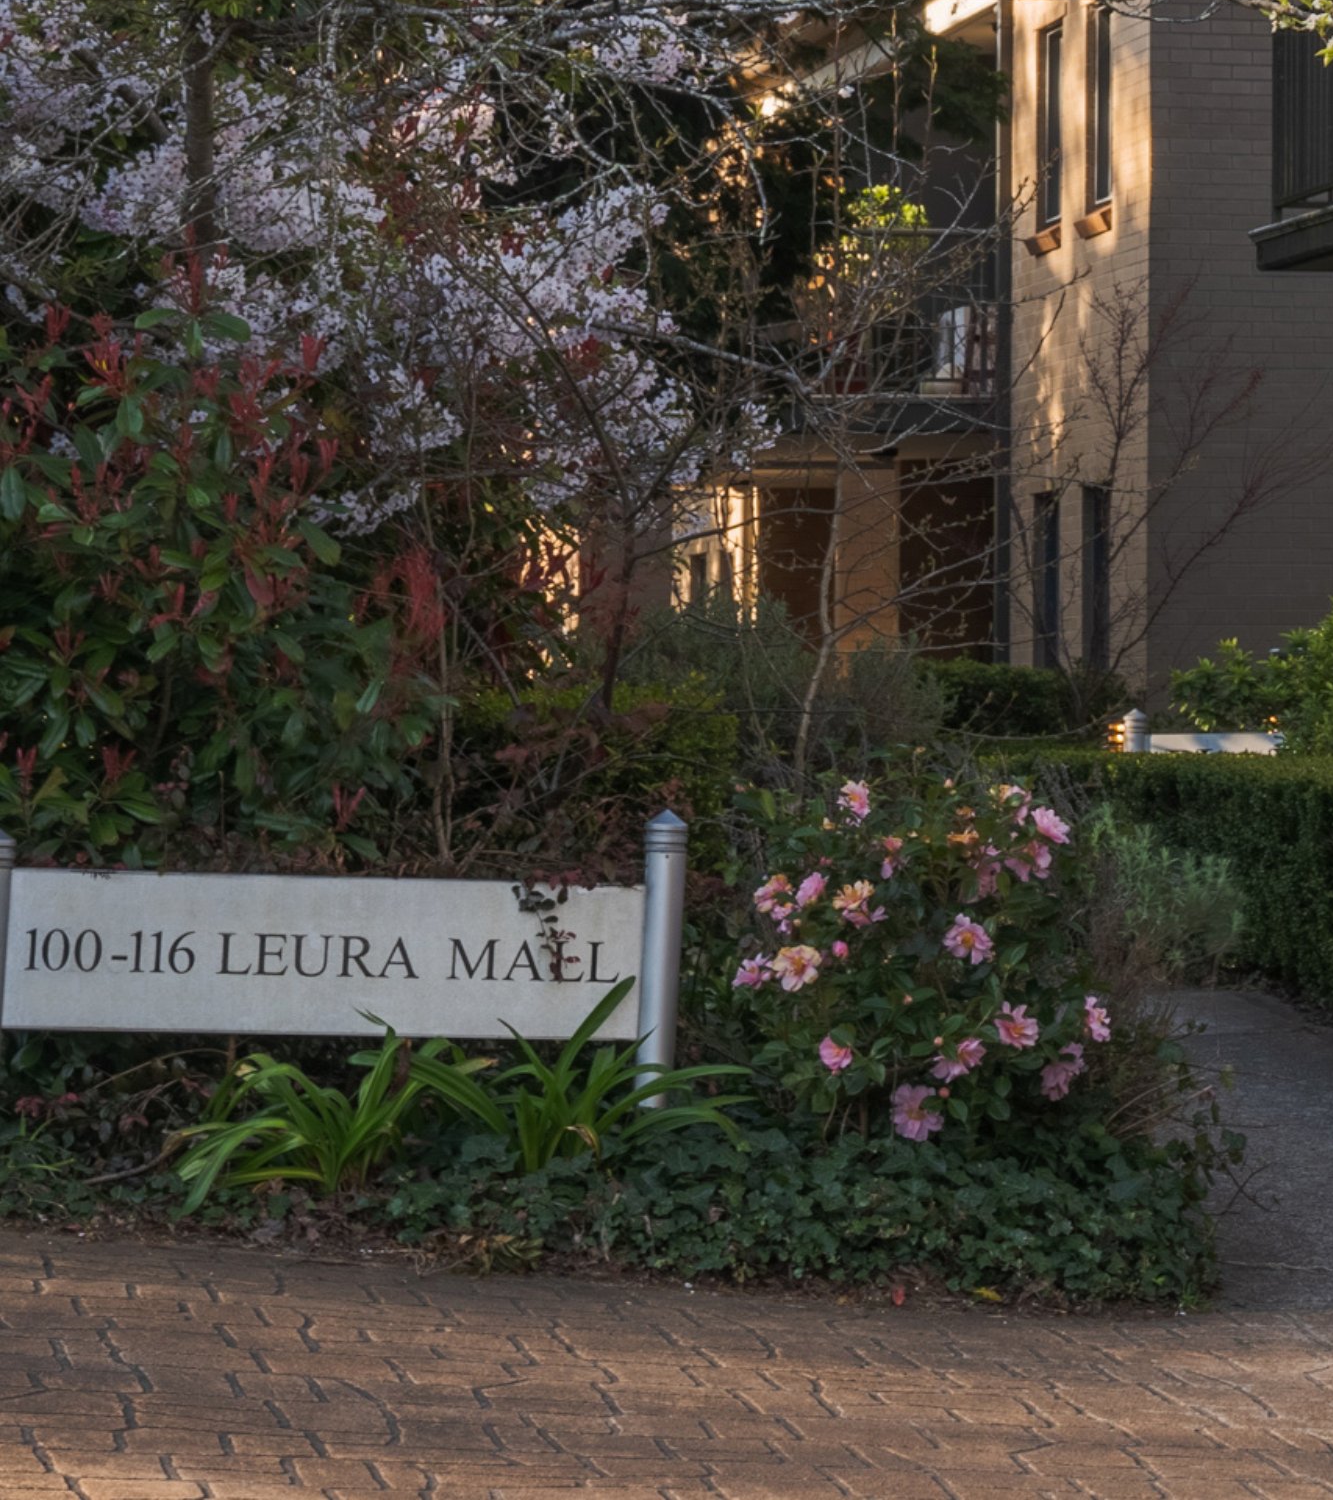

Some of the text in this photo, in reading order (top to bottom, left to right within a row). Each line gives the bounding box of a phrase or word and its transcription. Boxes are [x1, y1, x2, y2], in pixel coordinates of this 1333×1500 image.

[23, 927, 621, 984] 100-116 LEURA MALL
